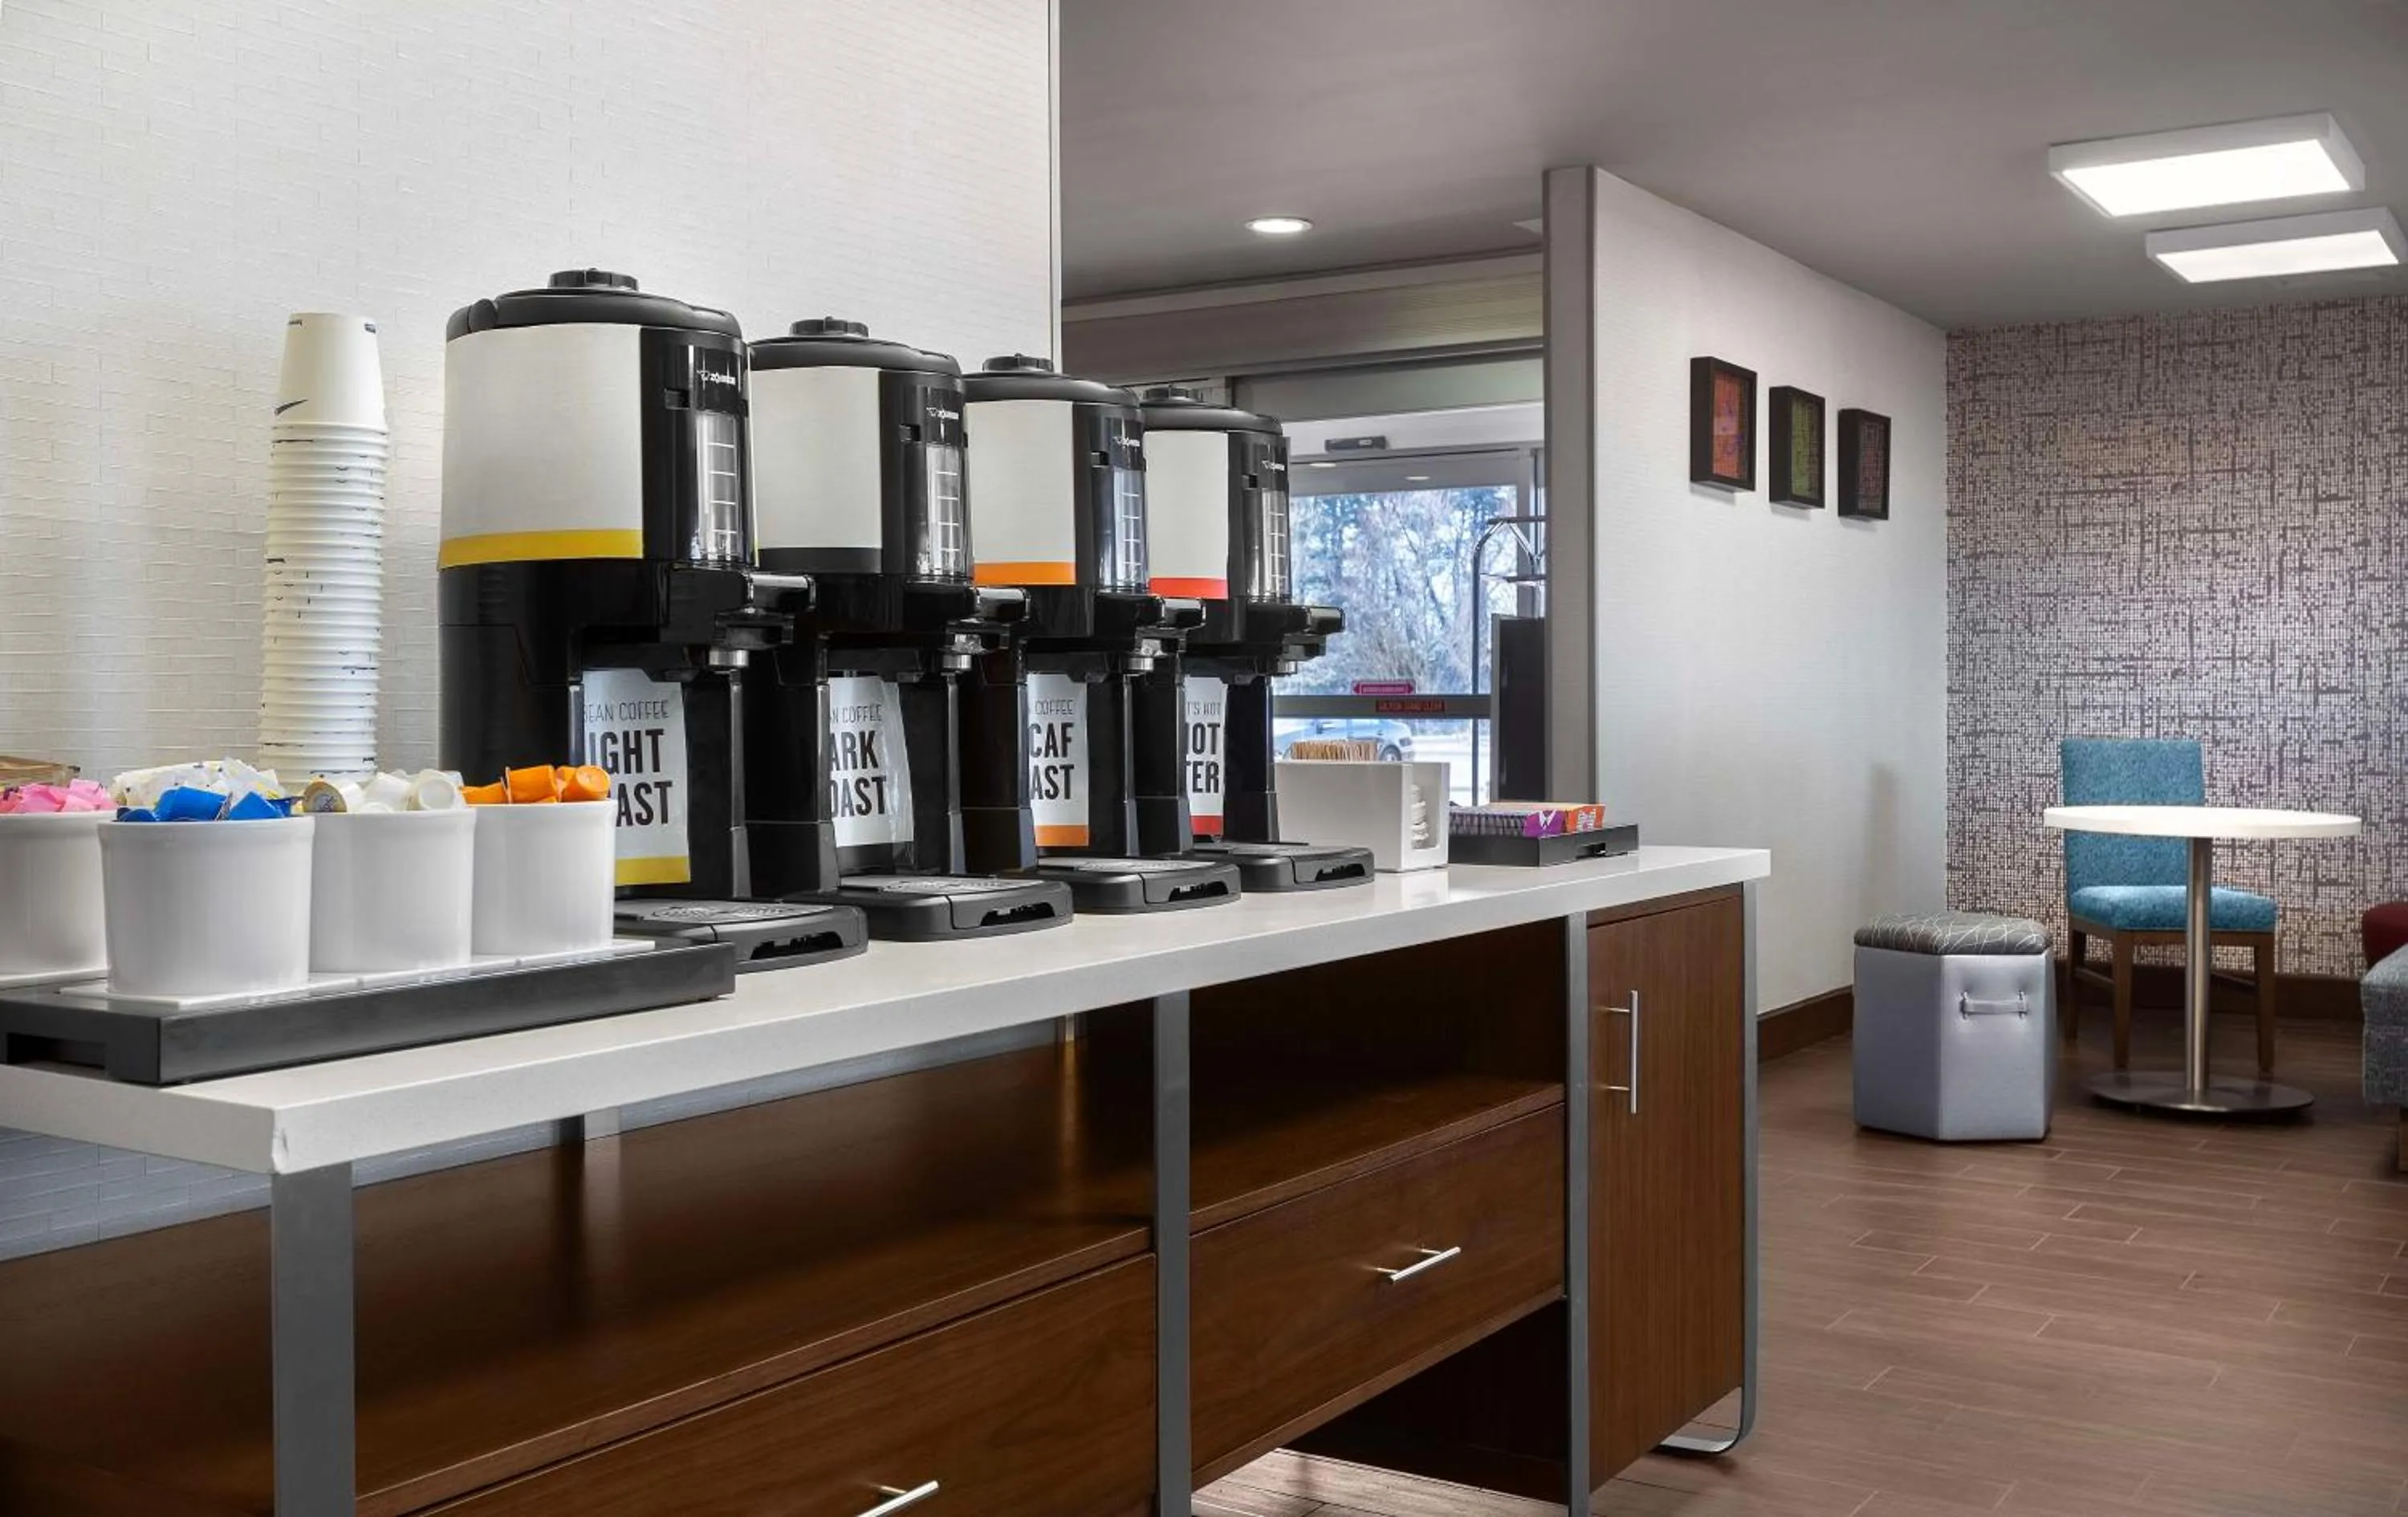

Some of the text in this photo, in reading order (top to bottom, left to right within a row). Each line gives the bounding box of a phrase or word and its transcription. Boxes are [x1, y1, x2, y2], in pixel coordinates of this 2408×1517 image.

[619, 699, 669, 721] COFFEE
[843, 704, 882, 723] COFFEE
[588, 729, 665, 775] IGHT
[830, 730, 879, 771] ARK
[1028, 722, 1074, 758] CAF
[1192, 722, 1221, 754] OT
[830, 775, 887, 817] OAST
[1031, 764, 1075, 799] AST
[616, 780, 673, 827] AST
